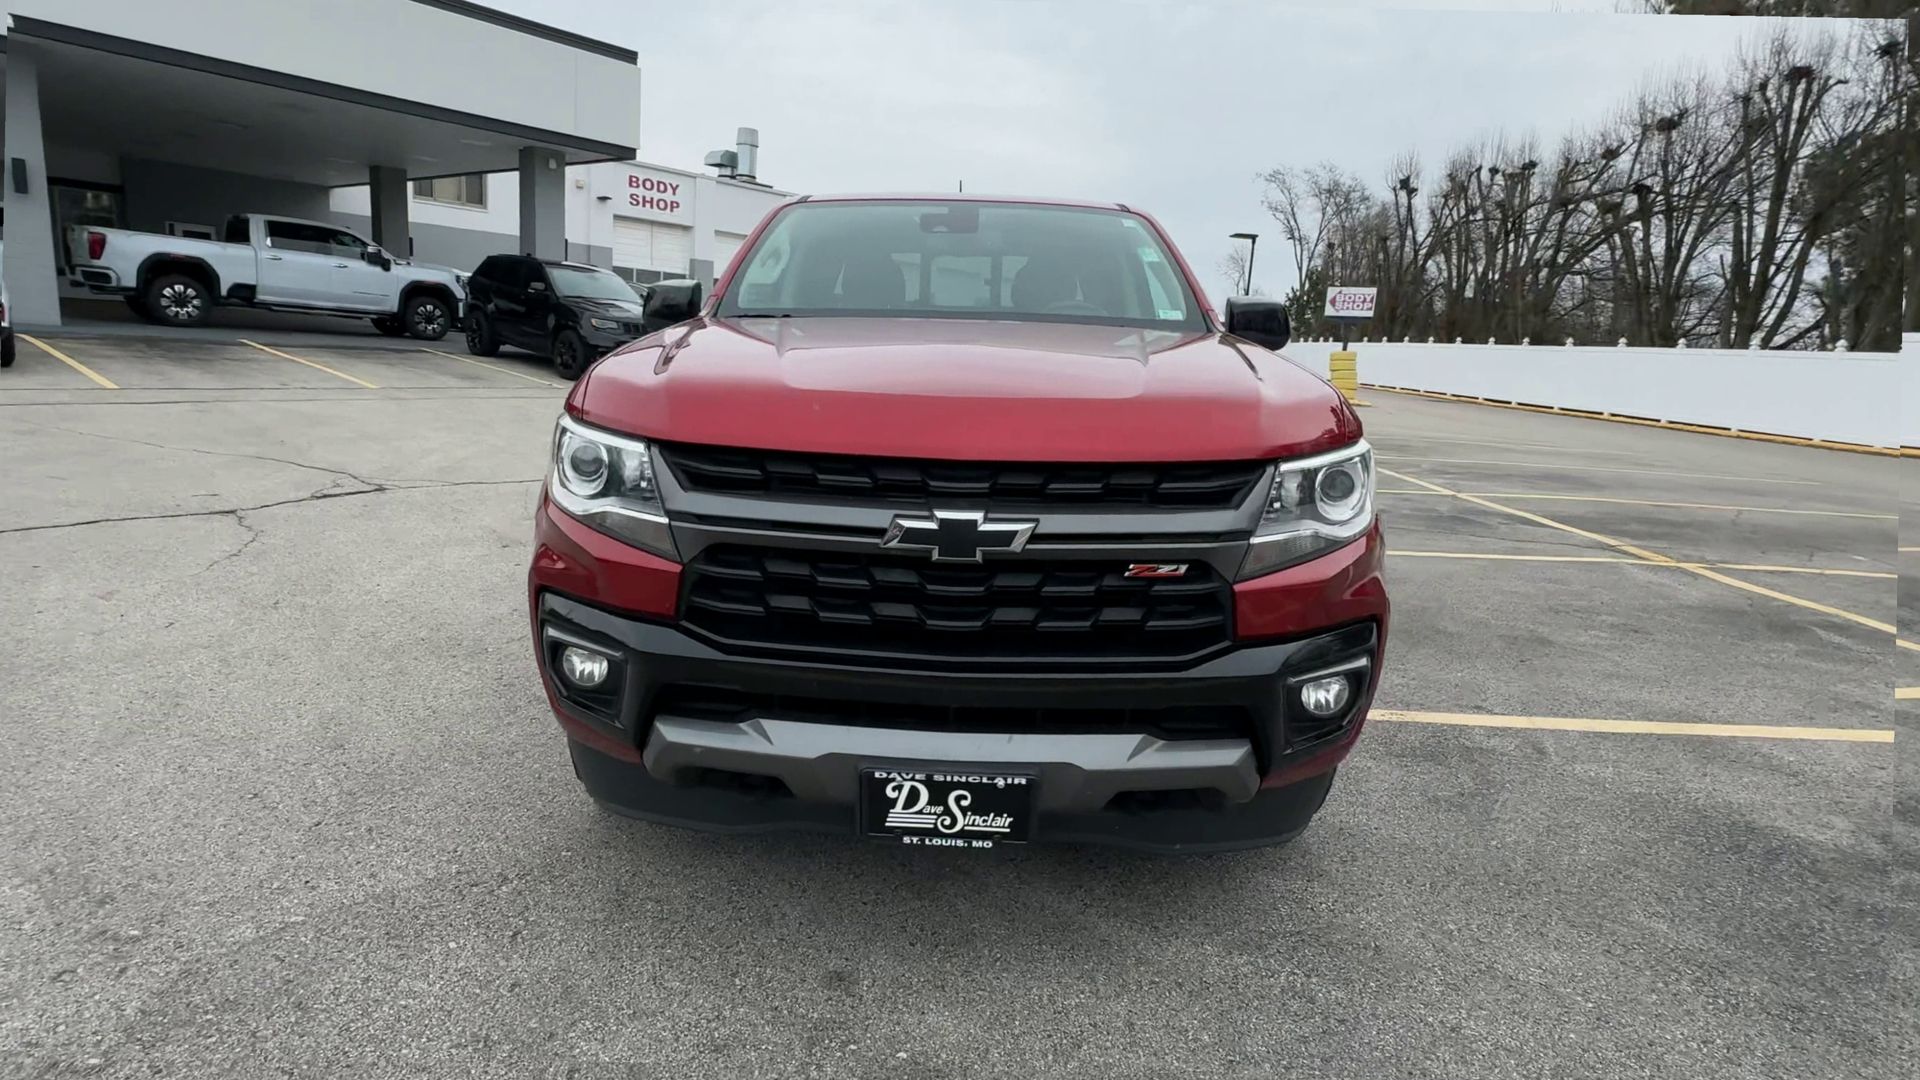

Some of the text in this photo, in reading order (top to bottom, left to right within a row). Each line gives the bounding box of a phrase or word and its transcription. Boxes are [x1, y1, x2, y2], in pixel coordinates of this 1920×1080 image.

[628, 175, 679, 196] BODY
[629, 193, 680, 213] SHOP
[1335, 301, 1372, 310] SHOP
[1336, 294, 1373, 303] BODY
[874, 771, 1027, 785] DAVE SINCLAIR
[885, 781, 1013, 834] Dave Sinclair
[902, 836, 921, 845] ST.
[972, 840, 993, 848] MO
